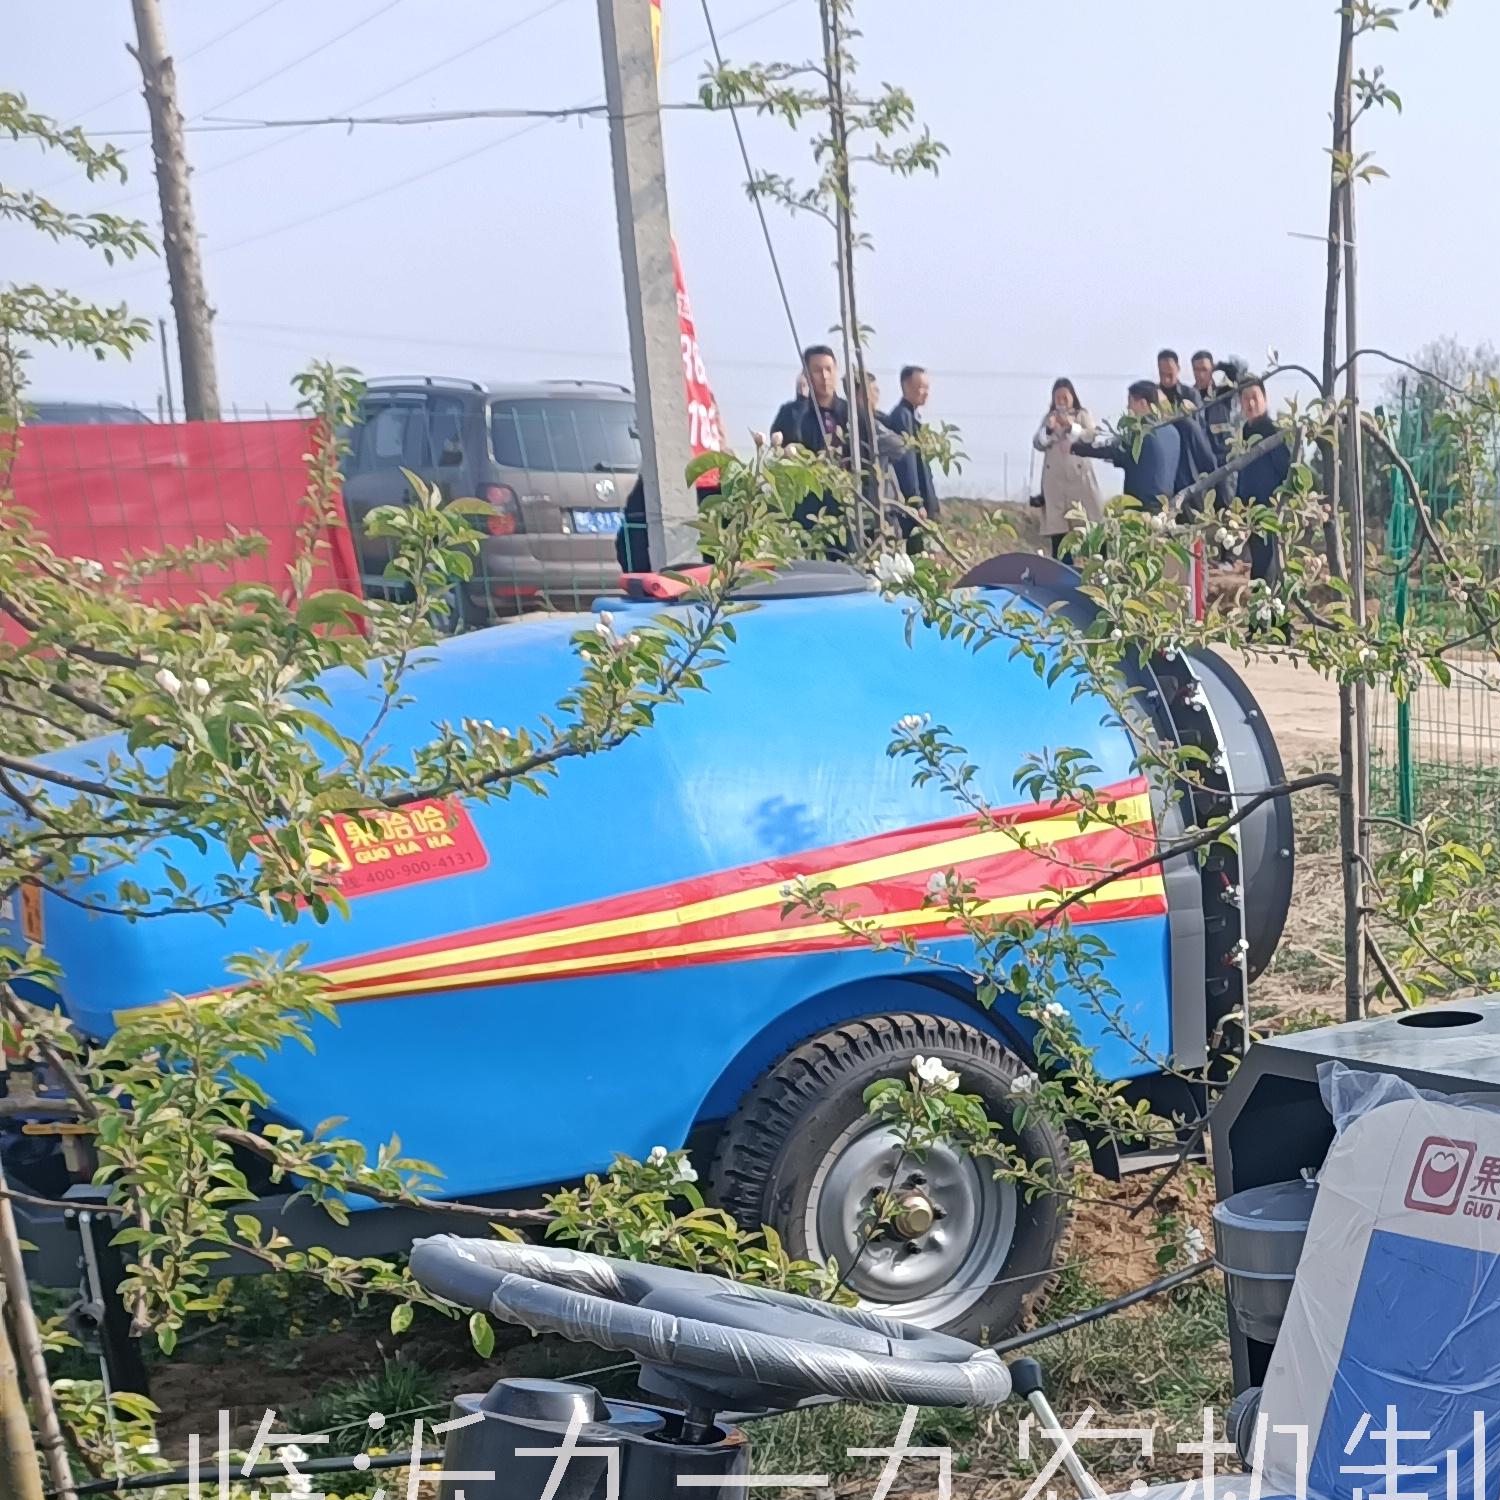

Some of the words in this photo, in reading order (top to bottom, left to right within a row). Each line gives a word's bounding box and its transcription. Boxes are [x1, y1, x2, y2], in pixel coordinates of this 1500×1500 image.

[343, 806, 447, 848] 果哈哈
[355, 846, 392, 864] GUO
[393, 841, 422, 856] HA
[426, 833, 455, 848] HA
[366, 851, 475, 884] 400-900-4131
[1462, 1200, 1494, 1219] GUO
